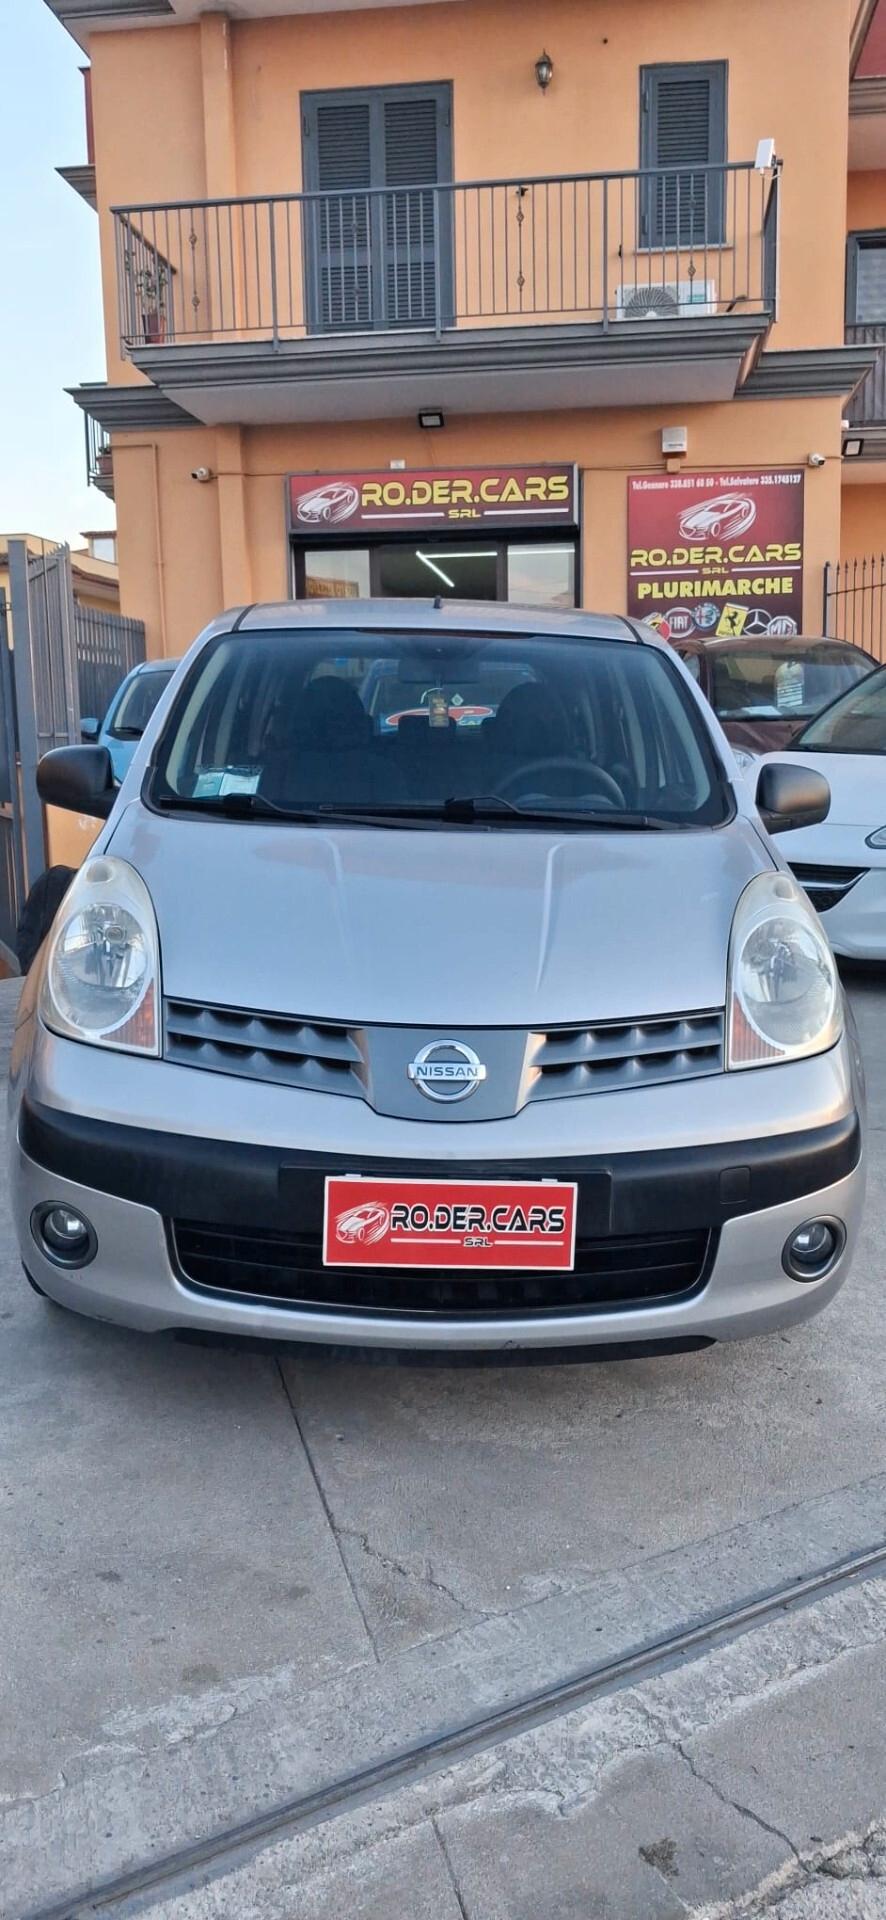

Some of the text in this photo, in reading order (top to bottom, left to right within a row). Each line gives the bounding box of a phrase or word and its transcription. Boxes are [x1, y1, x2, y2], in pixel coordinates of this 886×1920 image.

[361, 475, 570, 507] RO.DER.CARS
[448, 509, 482, 519] SRL
[630, 543, 802, 567] RO.DER.CARS
[702, 566, 730, 575] SRL
[637, 577, 794, 600] PLURIMARCHE
[668, 615, 689, 630] FIAT
[416, 1066, 479, 1077] NISSAN
[389, 1203, 568, 1233] RO.DER.CARS
[463, 1236, 494, 1248] SRL
